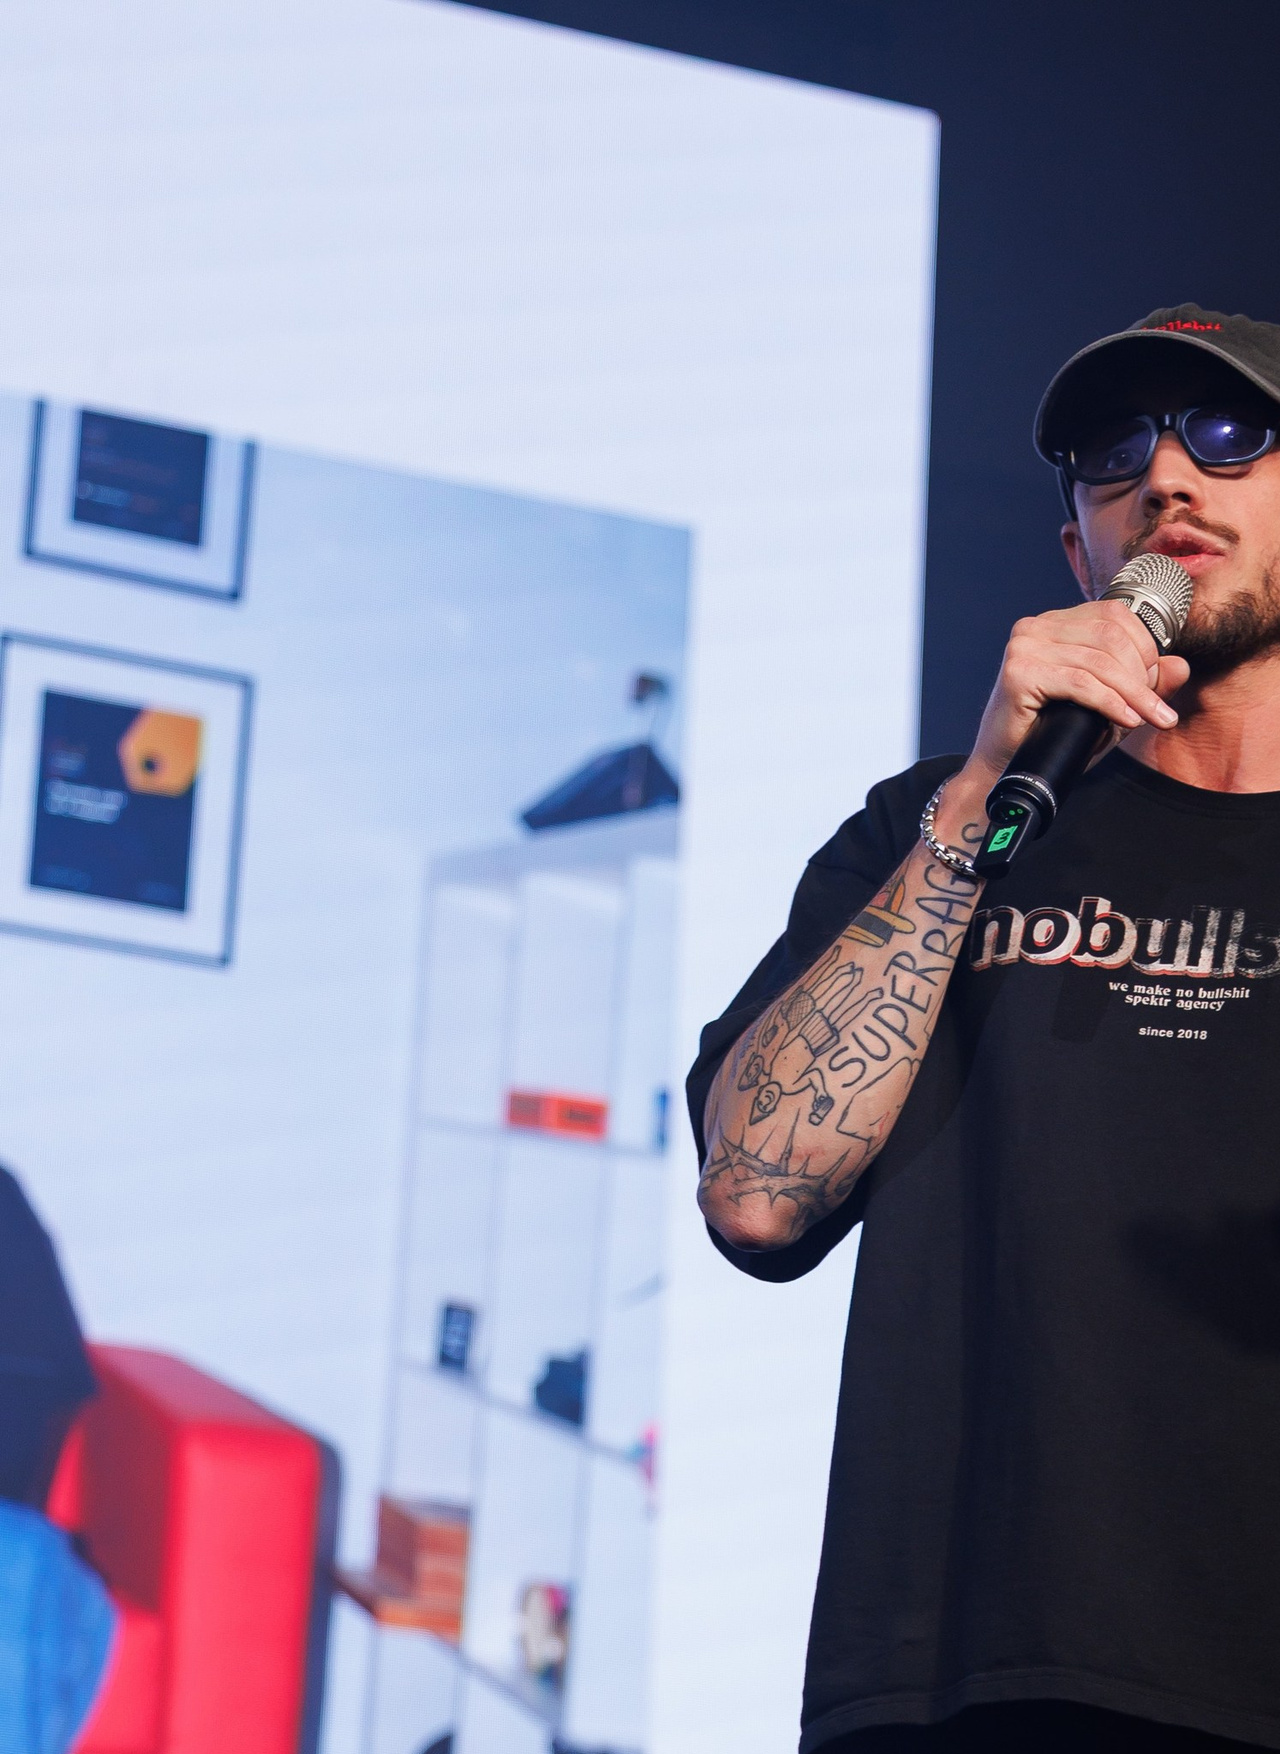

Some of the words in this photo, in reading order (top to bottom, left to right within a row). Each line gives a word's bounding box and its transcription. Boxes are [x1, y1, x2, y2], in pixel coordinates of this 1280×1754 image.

[993, 832, 1010, 845] 3
[1108, 981, 1129, 992] we
[1133, 984, 1172, 996] make
[1175, 988, 1194, 998] no
[1198, 986, 1251, 999] bullshit
[1124, 994, 1172, 1007] spektr
[1175, 999, 1226, 1012] agency
[1138, 1026, 1174, 1038] since
[1176, 1028, 1208, 1040] 2018
